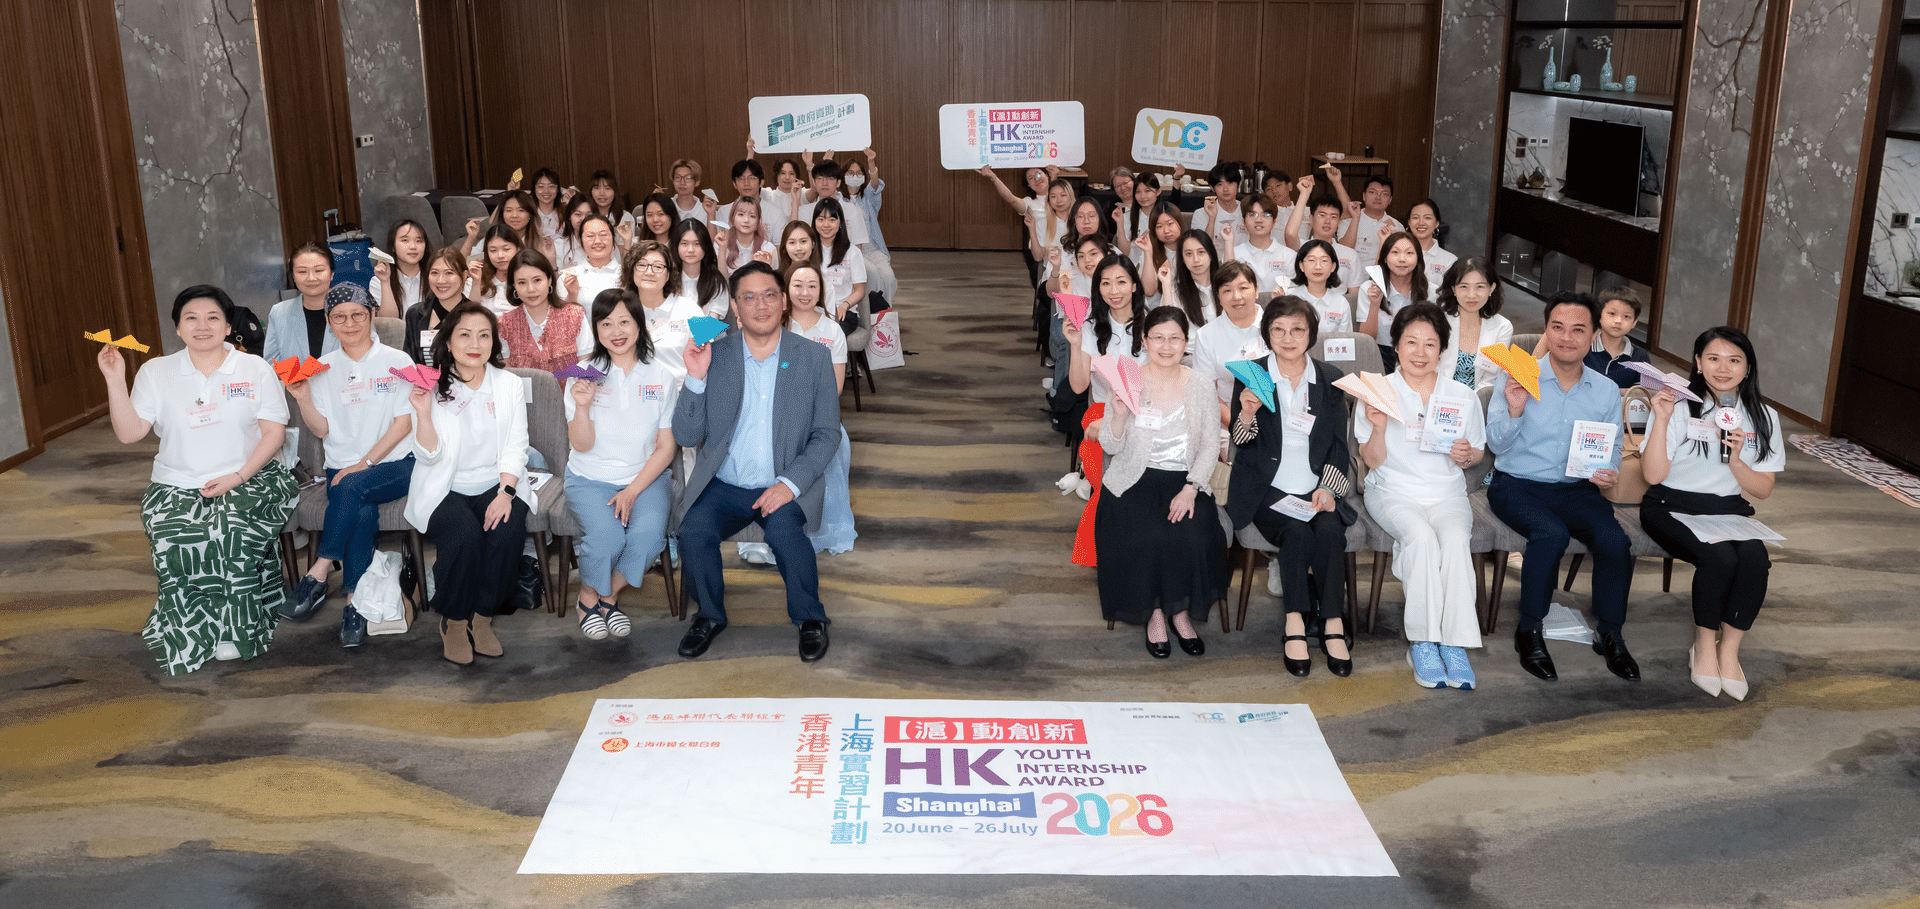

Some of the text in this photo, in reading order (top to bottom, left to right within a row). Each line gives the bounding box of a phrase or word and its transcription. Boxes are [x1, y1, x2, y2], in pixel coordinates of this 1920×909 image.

[810, 124, 840, 139] programme
[967, 108, 977, 147] 香港青年
[990, 123, 1021, 141] HK
[994, 144, 1024, 153] Shanghai
[1028, 141, 1058, 159] 2026
[1585, 437, 1597, 445] HK
[789, 713, 833, 799] 香港青年
[1014, 748, 1092, 760] YOUTH
[884, 747, 1012, 787] HK
[1016, 763, 1148, 775] INTERNSHIP
[830, 712, 875, 846] 上海實習計劃
[1018, 775, 1105, 787] AWARD
[896, 797, 1021, 816] Shanghai
[1041, 792, 1174, 838] 2026
[882, 822, 954, 834] 20June
[974, 822, 1038, 836] 26July
